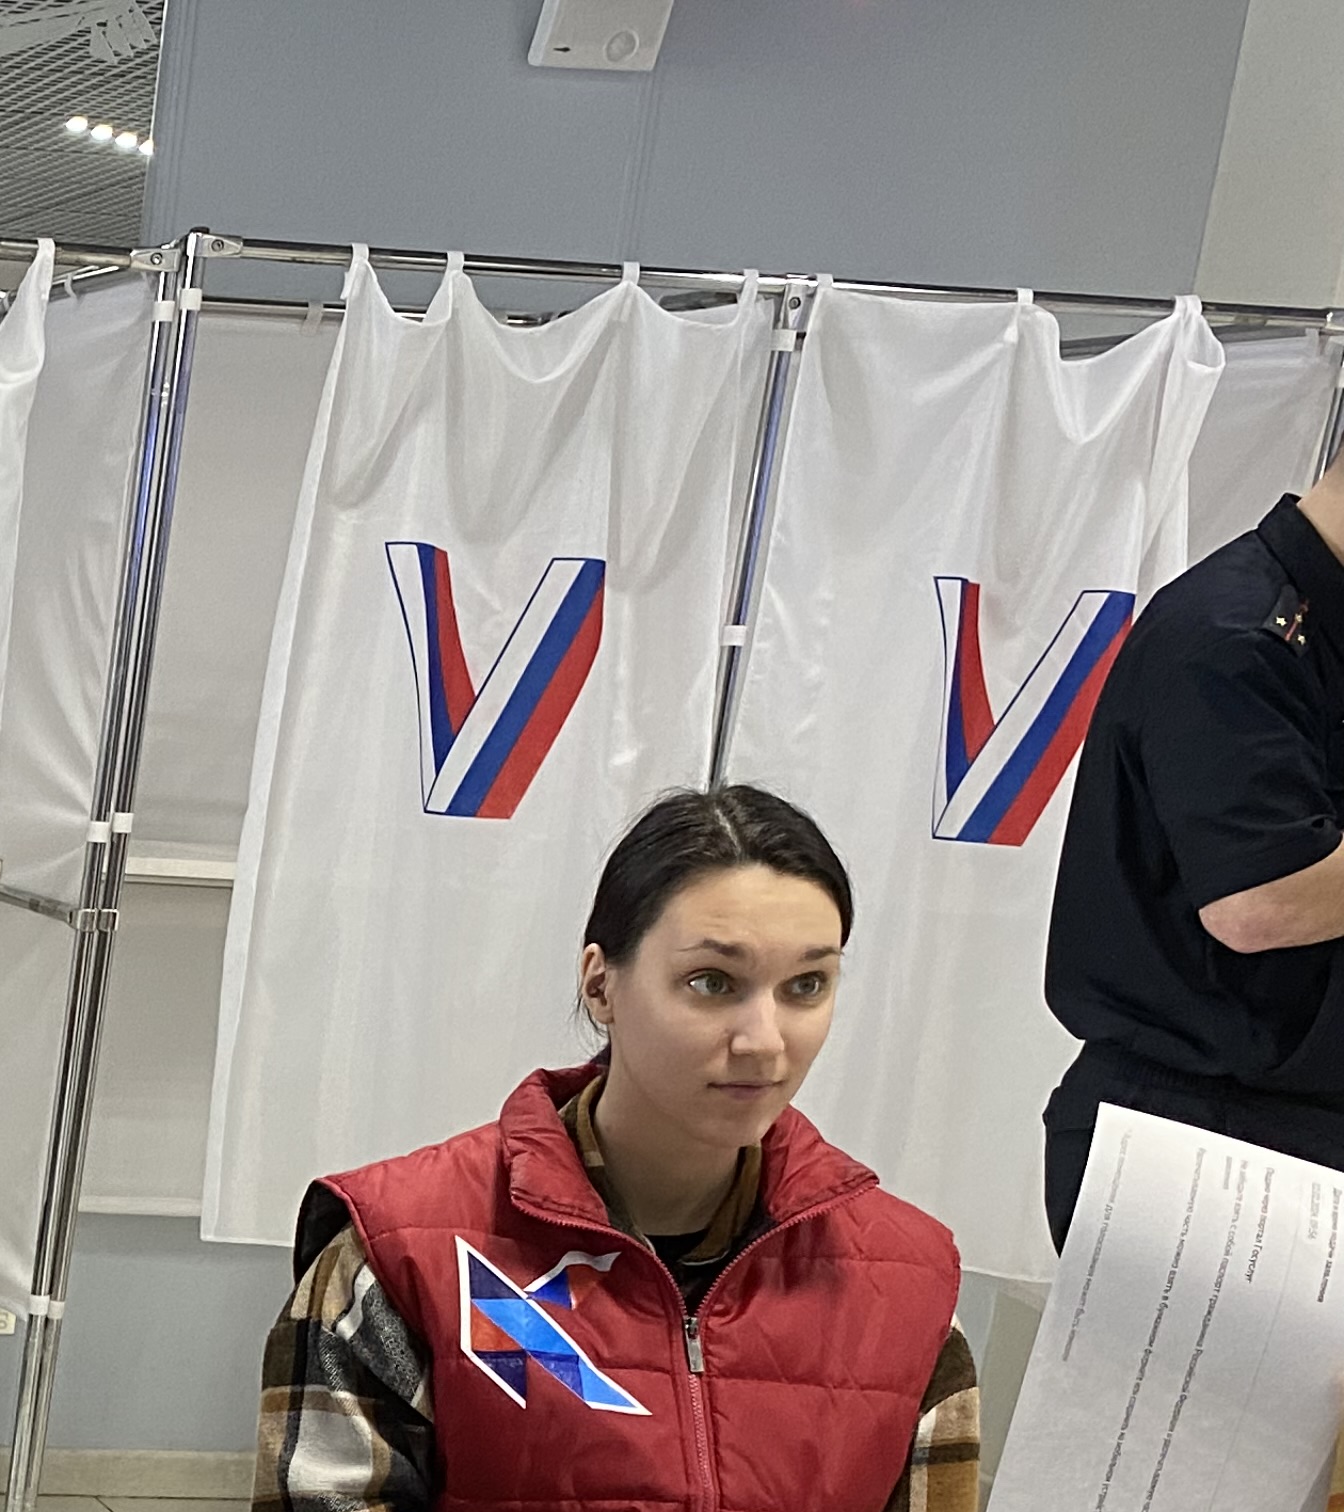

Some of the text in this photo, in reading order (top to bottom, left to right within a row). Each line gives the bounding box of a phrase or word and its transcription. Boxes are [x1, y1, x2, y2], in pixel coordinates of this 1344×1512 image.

[1221, 1230, 1236, 1257] собой
[1211, 1257, 1229, 1293] паспорт
[1243, 1243, 1262, 1284] Госуслуг
[1162, 1269, 1177, 1295] взять
